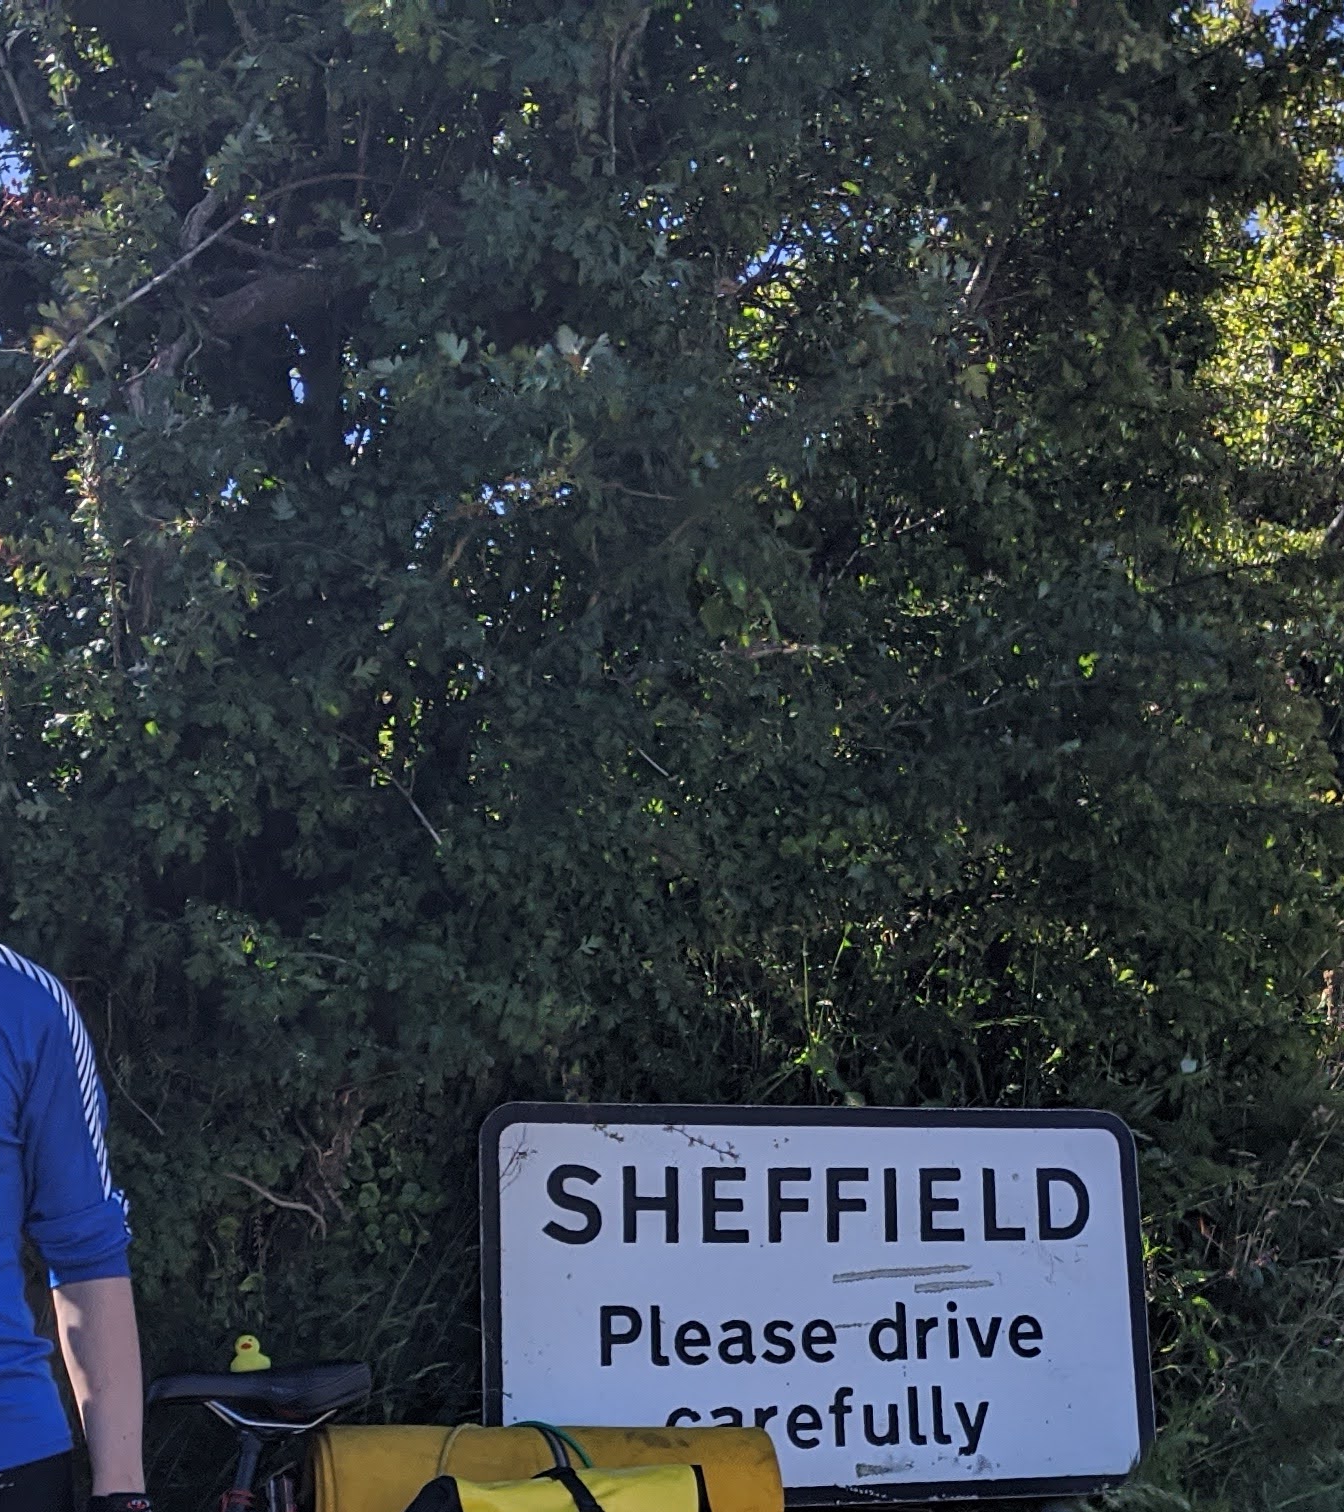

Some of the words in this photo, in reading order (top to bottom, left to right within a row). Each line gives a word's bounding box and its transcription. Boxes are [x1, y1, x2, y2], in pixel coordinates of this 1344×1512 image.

[542, 1163, 1091, 1245] SHEFFIELD
[600, 1304, 838, 1367] Please
[868, 1301, 1044, 1362] drive
